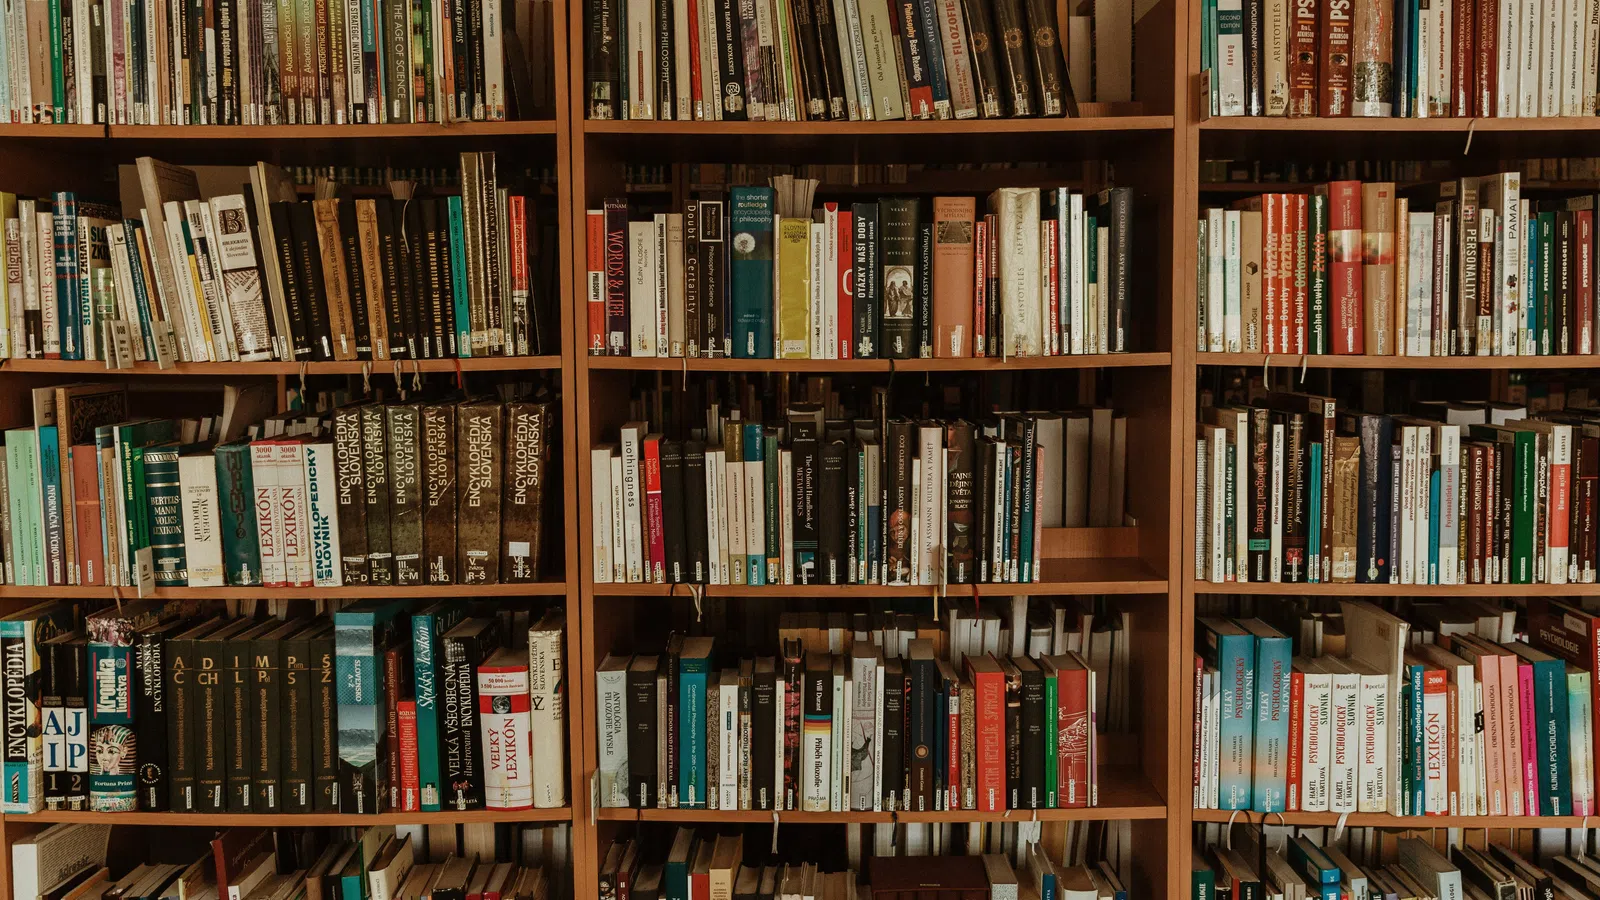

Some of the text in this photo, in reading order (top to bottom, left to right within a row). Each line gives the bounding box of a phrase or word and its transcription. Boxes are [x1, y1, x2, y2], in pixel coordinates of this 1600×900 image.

[282, 25, 293, 73] Akademická
[301, 26, 312, 73] Akademická
[395, 4, 406, 99] THE AGE OF SCIENCE
[903, 4, 923, 82] Philosophy Basic Readings
[1272, 3, 1281, 62] ARISTOTELÉS
[1119, 200, 1127, 215] ECO
[592, 272, 600, 301] PHILOSOPHY
[608, 231, 624, 317] WORDS & LIFE
[687, 205, 698, 314] Doubt Certainty
[707, 246, 716, 275] Philosophy
[855, 216, 866, 299] OTÁZKY NAŠÍ DOBY
[1016, 197, 1026, 324] ARISTOTELÉS METAFYZIKA
[1117, 254, 1125, 275] KRÁSY
[1264, 233, 1278, 321] Bowlby Vazba
[1279, 233, 1293, 321] Bowlby Vazba
[1465, 229, 1477, 300] PERSONALITY
[1118, 277, 1126, 301] DĚJINY
[256, 446, 273, 454] 3000
[335, 414, 351, 505] ENCYKLOPÉDIA
[347, 414, 361, 486] SLOVENSKA
[363, 414, 377, 505] ENCYKLOPÉDIA
[372, 413, 385, 484] SLOVENSKA
[395, 413, 406, 505] ENCYKLOPÉDIA
[403, 413, 415, 484] SLOVENSKA
[428, 416, 439, 506] ENCYKLOPÉDIA
[437, 416, 448, 486] SLOVENSKA
[468, 416, 482, 507] ENCYKLOPÉDIA
[480, 416, 492, 489] SLOVENSKA
[515, 414, 529, 505] ENCYKLOPÉDIA
[527, 414, 540, 486] SLOVENSKA
[626, 441, 636, 508] nothingness
[1539, 456, 1547, 498] psychologie
[897, 486, 905, 524] OŠKLIVOSTI
[1255, 443, 1267, 533] Psychological Testing
[257, 488, 274, 558] LEXIKÓN
[281, 488, 299, 558] LEXIKÓN
[805, 523, 814, 531] of
[96, 659, 116, 713] Kronika
[144, 643, 153, 696] SLOVENSKÁ
[153, 643, 162, 712] ENCYKLOPÉDIA
[354, 660, 362, 702] SLOVENSKO
[417, 626, 434, 709] Školský lexikón
[816, 679, 824, 712] Will Durant
[1234, 657, 1245, 719] PSYCHOLOGICKÝ
[1243, 670, 1254, 711] SLOVNÍK
[1270, 659, 1282, 721] PSYCHOLOGICKÝ
[1281, 673, 1291, 713] SLOVNÍK
[1428, 677, 1444, 685] 2000
[6, 642, 27, 758] ENCYKLOPÉDIA
[43, 710, 63, 736] A
[68, 711, 84, 737] J
[441, 663, 460, 777] VEĽKÁ VŠEOBECNÁ
[459, 664, 473, 777] ilustrovaná ENCYKLOPÉDIA
[605, 692, 614, 756] FILOZOFIE MYSLE
[613, 691, 623, 735] ANTOLÓGIA
[690, 713, 698, 739] Philosophy
[1223, 689, 1233, 720] VELKÝ
[1259, 691, 1269, 722] VELKÝ
[1318, 693, 1329, 725] SLOVNÍK
[1346, 694, 1357, 726] SLOVNÍK
[1375, 693, 1386, 726] SLOVNÍK
[1488, 685, 1498, 749] FORENZNÁ PSYCHOLÓGIA
[1507, 685, 1516, 749] FORENZNÁ PSYCHOLÓGIA
[49, 743, 59, 768] I
[68, 744, 86, 769] P
[489, 728, 501, 770] VEĽKÝ
[504, 719, 518, 780] LEXIKÓN
[814, 738, 824, 788] Příběh filozofie
[1308, 704, 1319, 764] PSYCHOLOGICKÝ
[1335, 705, 1346, 765] PSYCHOLOGICKÝ
[1365, 705, 1376, 764] PSYCHOLOGICKÝ
[1426, 713, 1441, 781] LEXIKÓN
[1548, 719, 1558, 791] KLINICKÁ PSYCHOLÓGIA
[1318, 767, 1326, 799] HARTLOVÁ
[1345, 768, 1354, 799] HARTLOVÁ
[1366, 780, 1374, 799] HARTL
[1376, 767, 1384, 798] HARTLOVÁ
